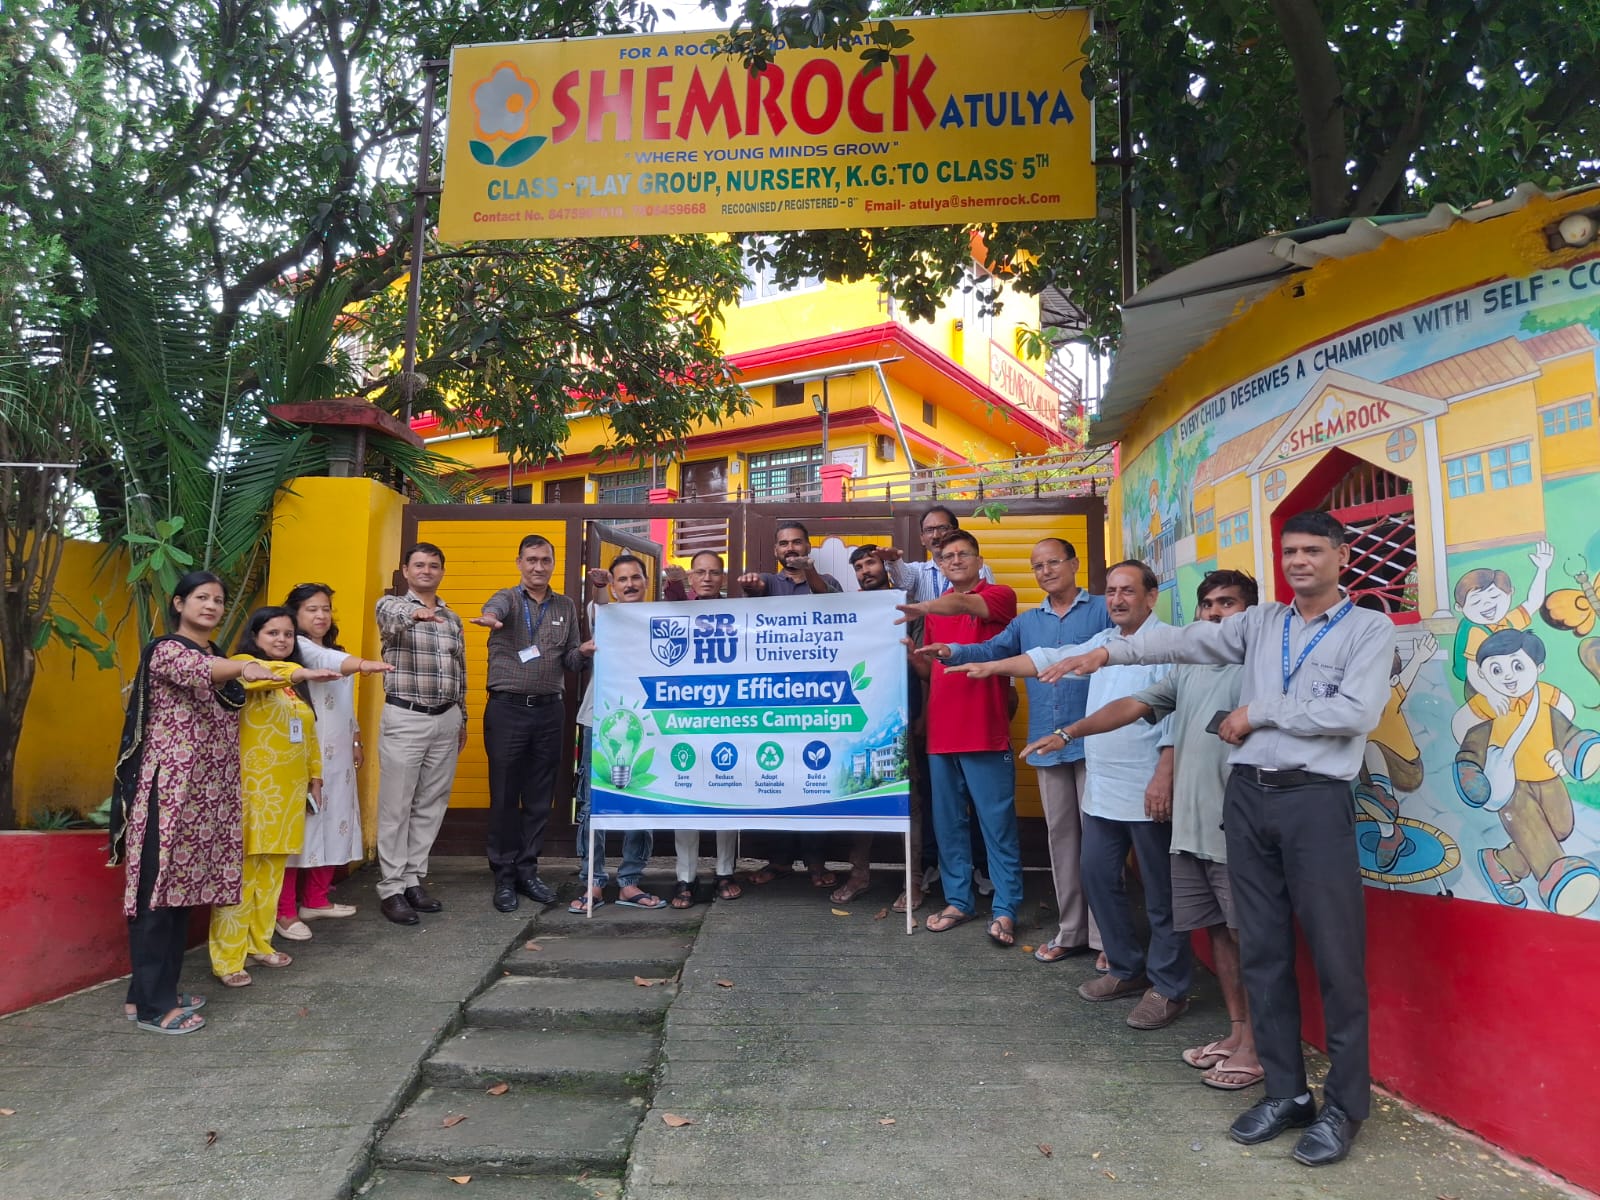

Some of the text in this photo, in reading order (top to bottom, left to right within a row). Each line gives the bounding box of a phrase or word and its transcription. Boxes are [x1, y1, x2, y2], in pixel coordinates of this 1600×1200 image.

[619, 48, 651, 59] FOR
[657, 47, 668, 58] A
[551, 53, 1074, 144] SHEMROCK ATULYA
[703, 148, 764, 161] YOUNG
[769, 145, 828, 157] MINDS
[487, 176, 559, 201] CLASS
[576, 174, 631, 197] PLAY
[638, 171, 721, 198] GROUP,
[726, 167, 840, 193] NURSERY,
[898, 163, 928, 184] TO
[937, 158, 1014, 182] CLASS
[909, 193, 1061, 212] atulya@shemrock.Com
[473, 210, 521, 223] Contact
[524, 209, 544, 221] No.
[1180, 411, 1200, 441] EVERY
[1200, 397, 1226, 426] CHILD
[1230, 365, 1290, 410] DESERVES
[1296, 359, 1306, 379] A
[1313, 321, 1405, 372] CHAMPION
[1413, 299, 1469, 334] WITH
[1290, 400, 1391, 452] SHEMROCK
[693, 613, 738, 638] SR
[755, 611, 857, 627] Swami Rama
[755, 629, 844, 646] Himalayan
[693, 638, 738, 664] HU
[756, 645, 839, 663] University
[655, 677, 846, 705] Energy Efficiency
[665, 709, 853, 730] Awareness Campaign
[708, 780, 743, 788] Consumption
